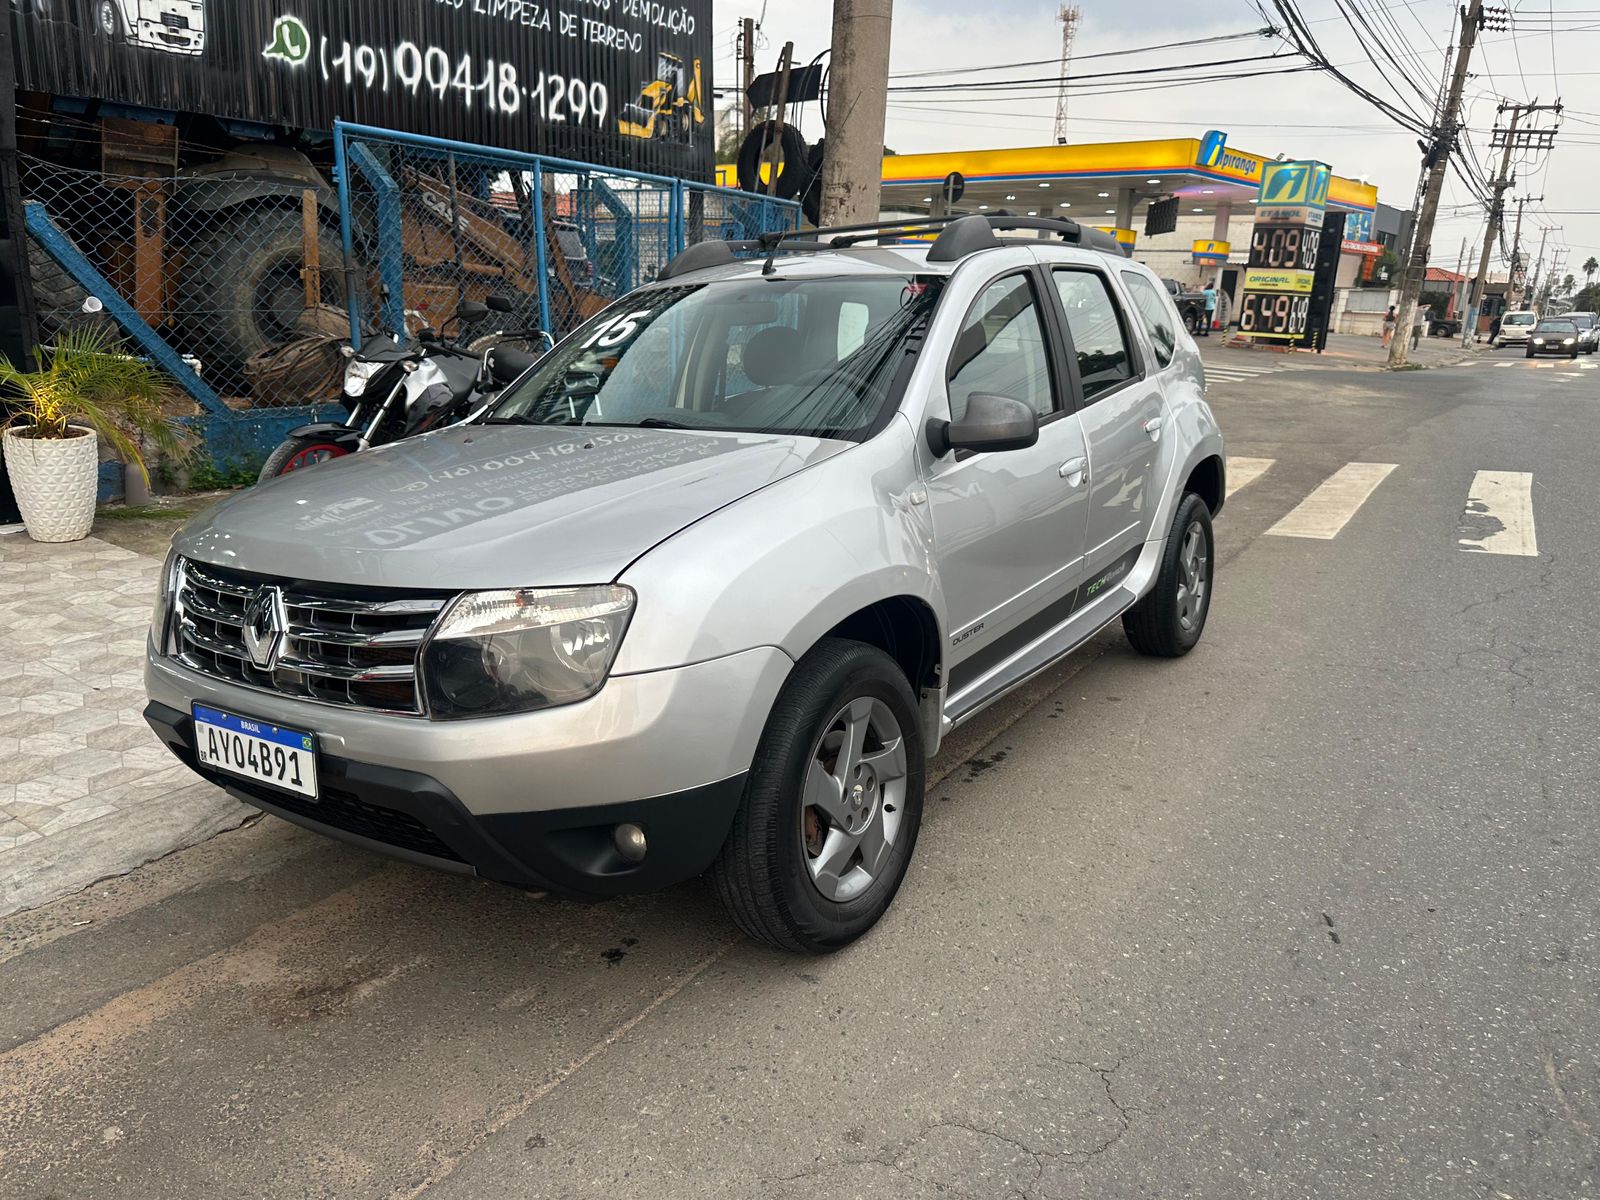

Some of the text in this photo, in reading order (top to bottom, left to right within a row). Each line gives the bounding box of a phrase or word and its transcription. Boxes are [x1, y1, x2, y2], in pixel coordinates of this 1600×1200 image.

[473, 0, 642, 53] LIMPEZA DE TERRENO
[579, 309, 652, 349] 15
[952, 621, 985, 646] DUSTER
[240, 720, 261, 734] BRASIL
